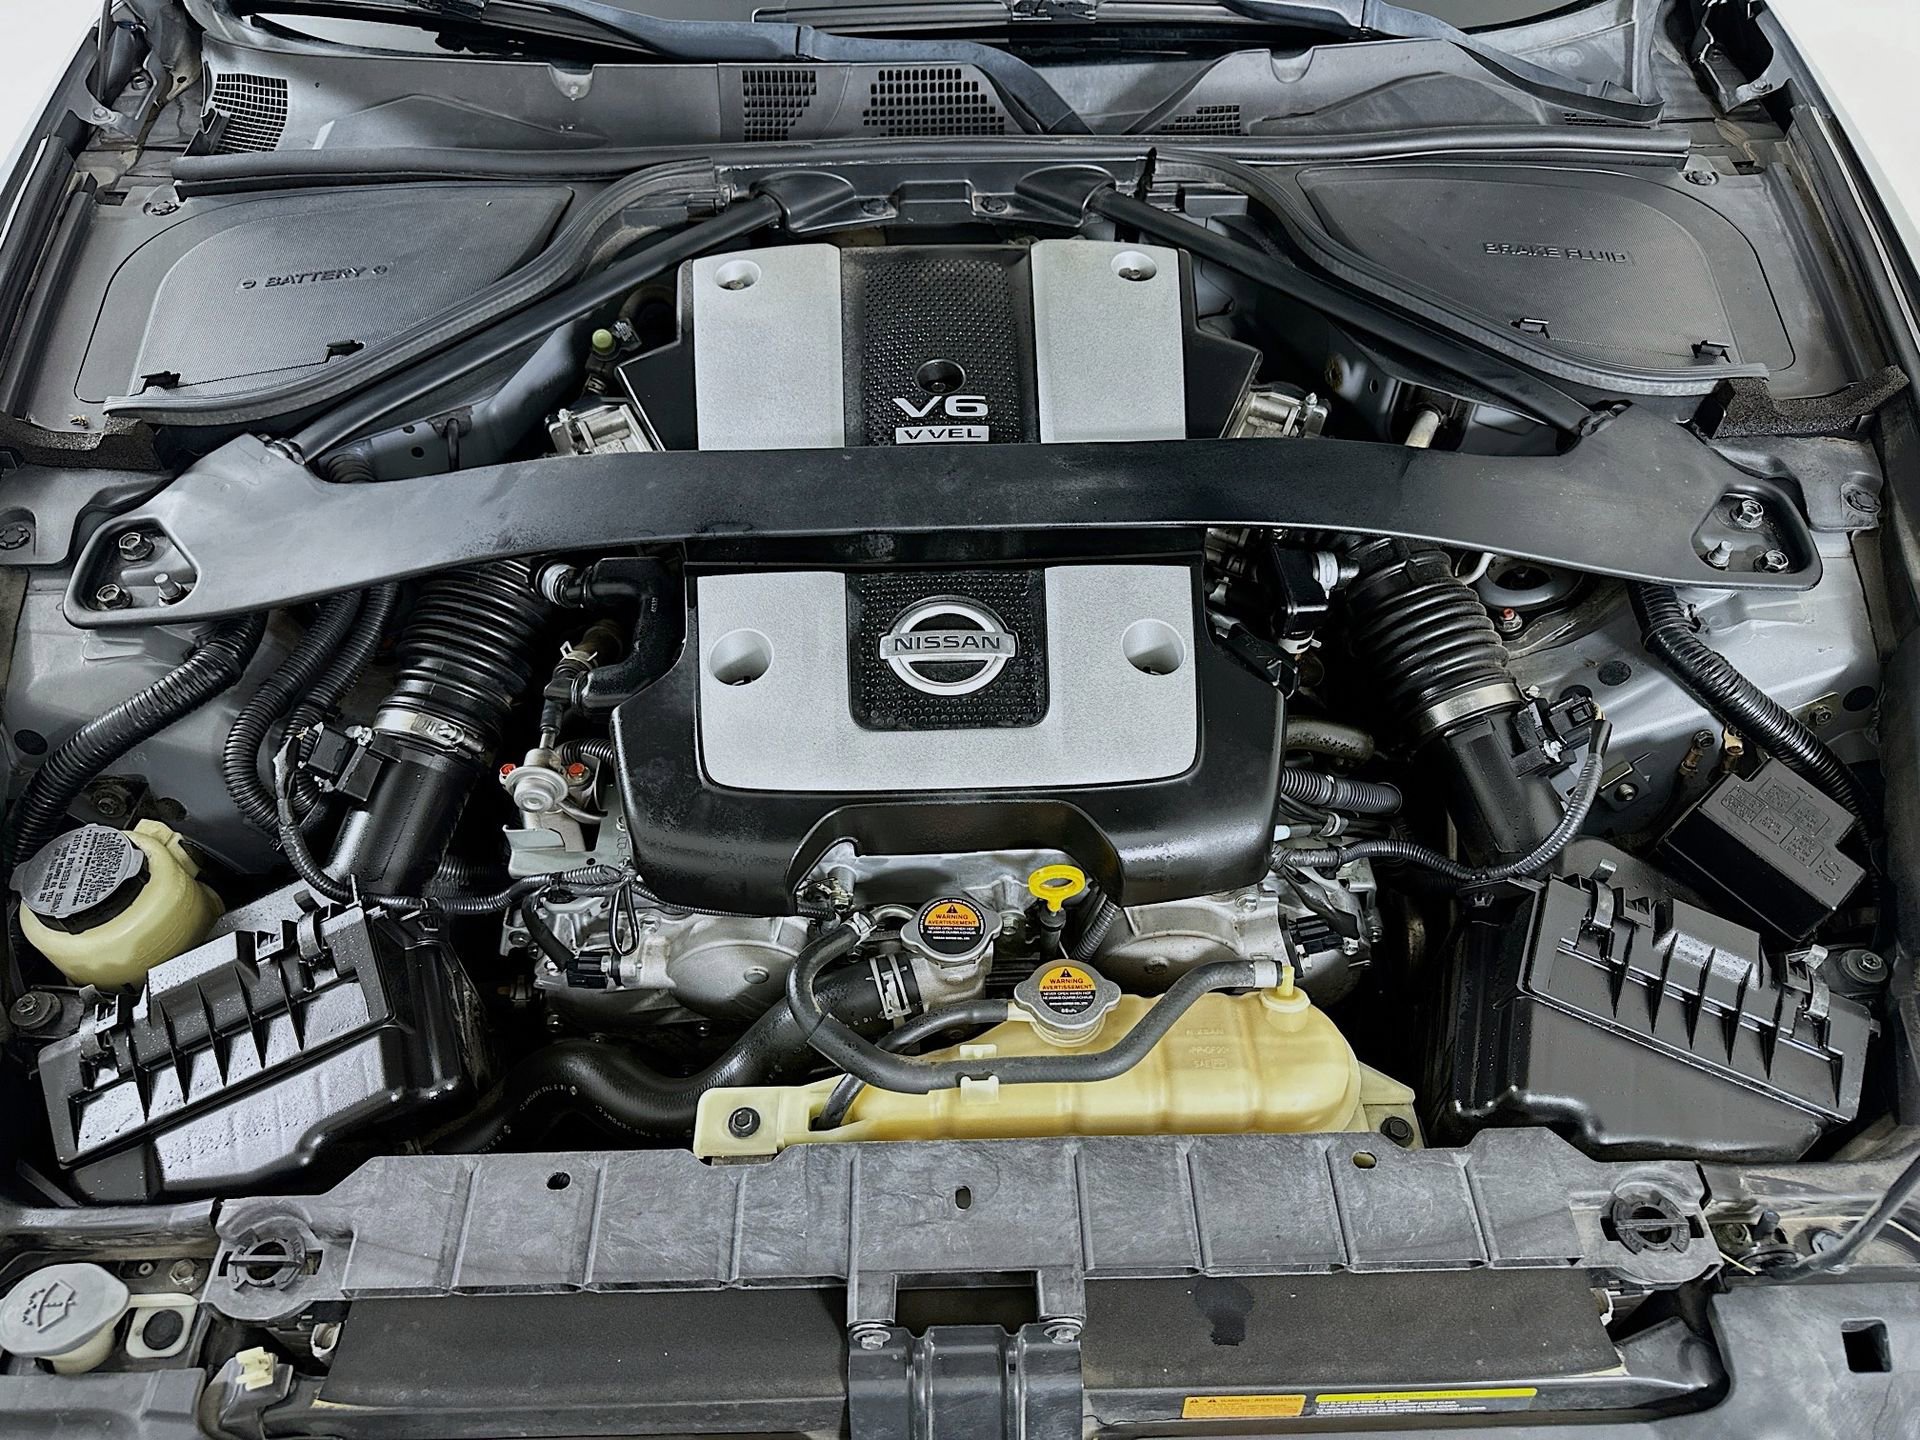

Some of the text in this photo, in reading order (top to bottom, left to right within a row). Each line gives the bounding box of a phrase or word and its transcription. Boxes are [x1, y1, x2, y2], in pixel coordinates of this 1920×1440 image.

[1484, 242, 1626, 263] BRAKE FLUID
[265, 266, 367, 288] BATTERY
[892, 395, 989, 418] V6
[904, 428, 982, 440] VVEL
[894, 635, 1001, 652] NISSAN
[59, 857, 75, 890] STEERING
